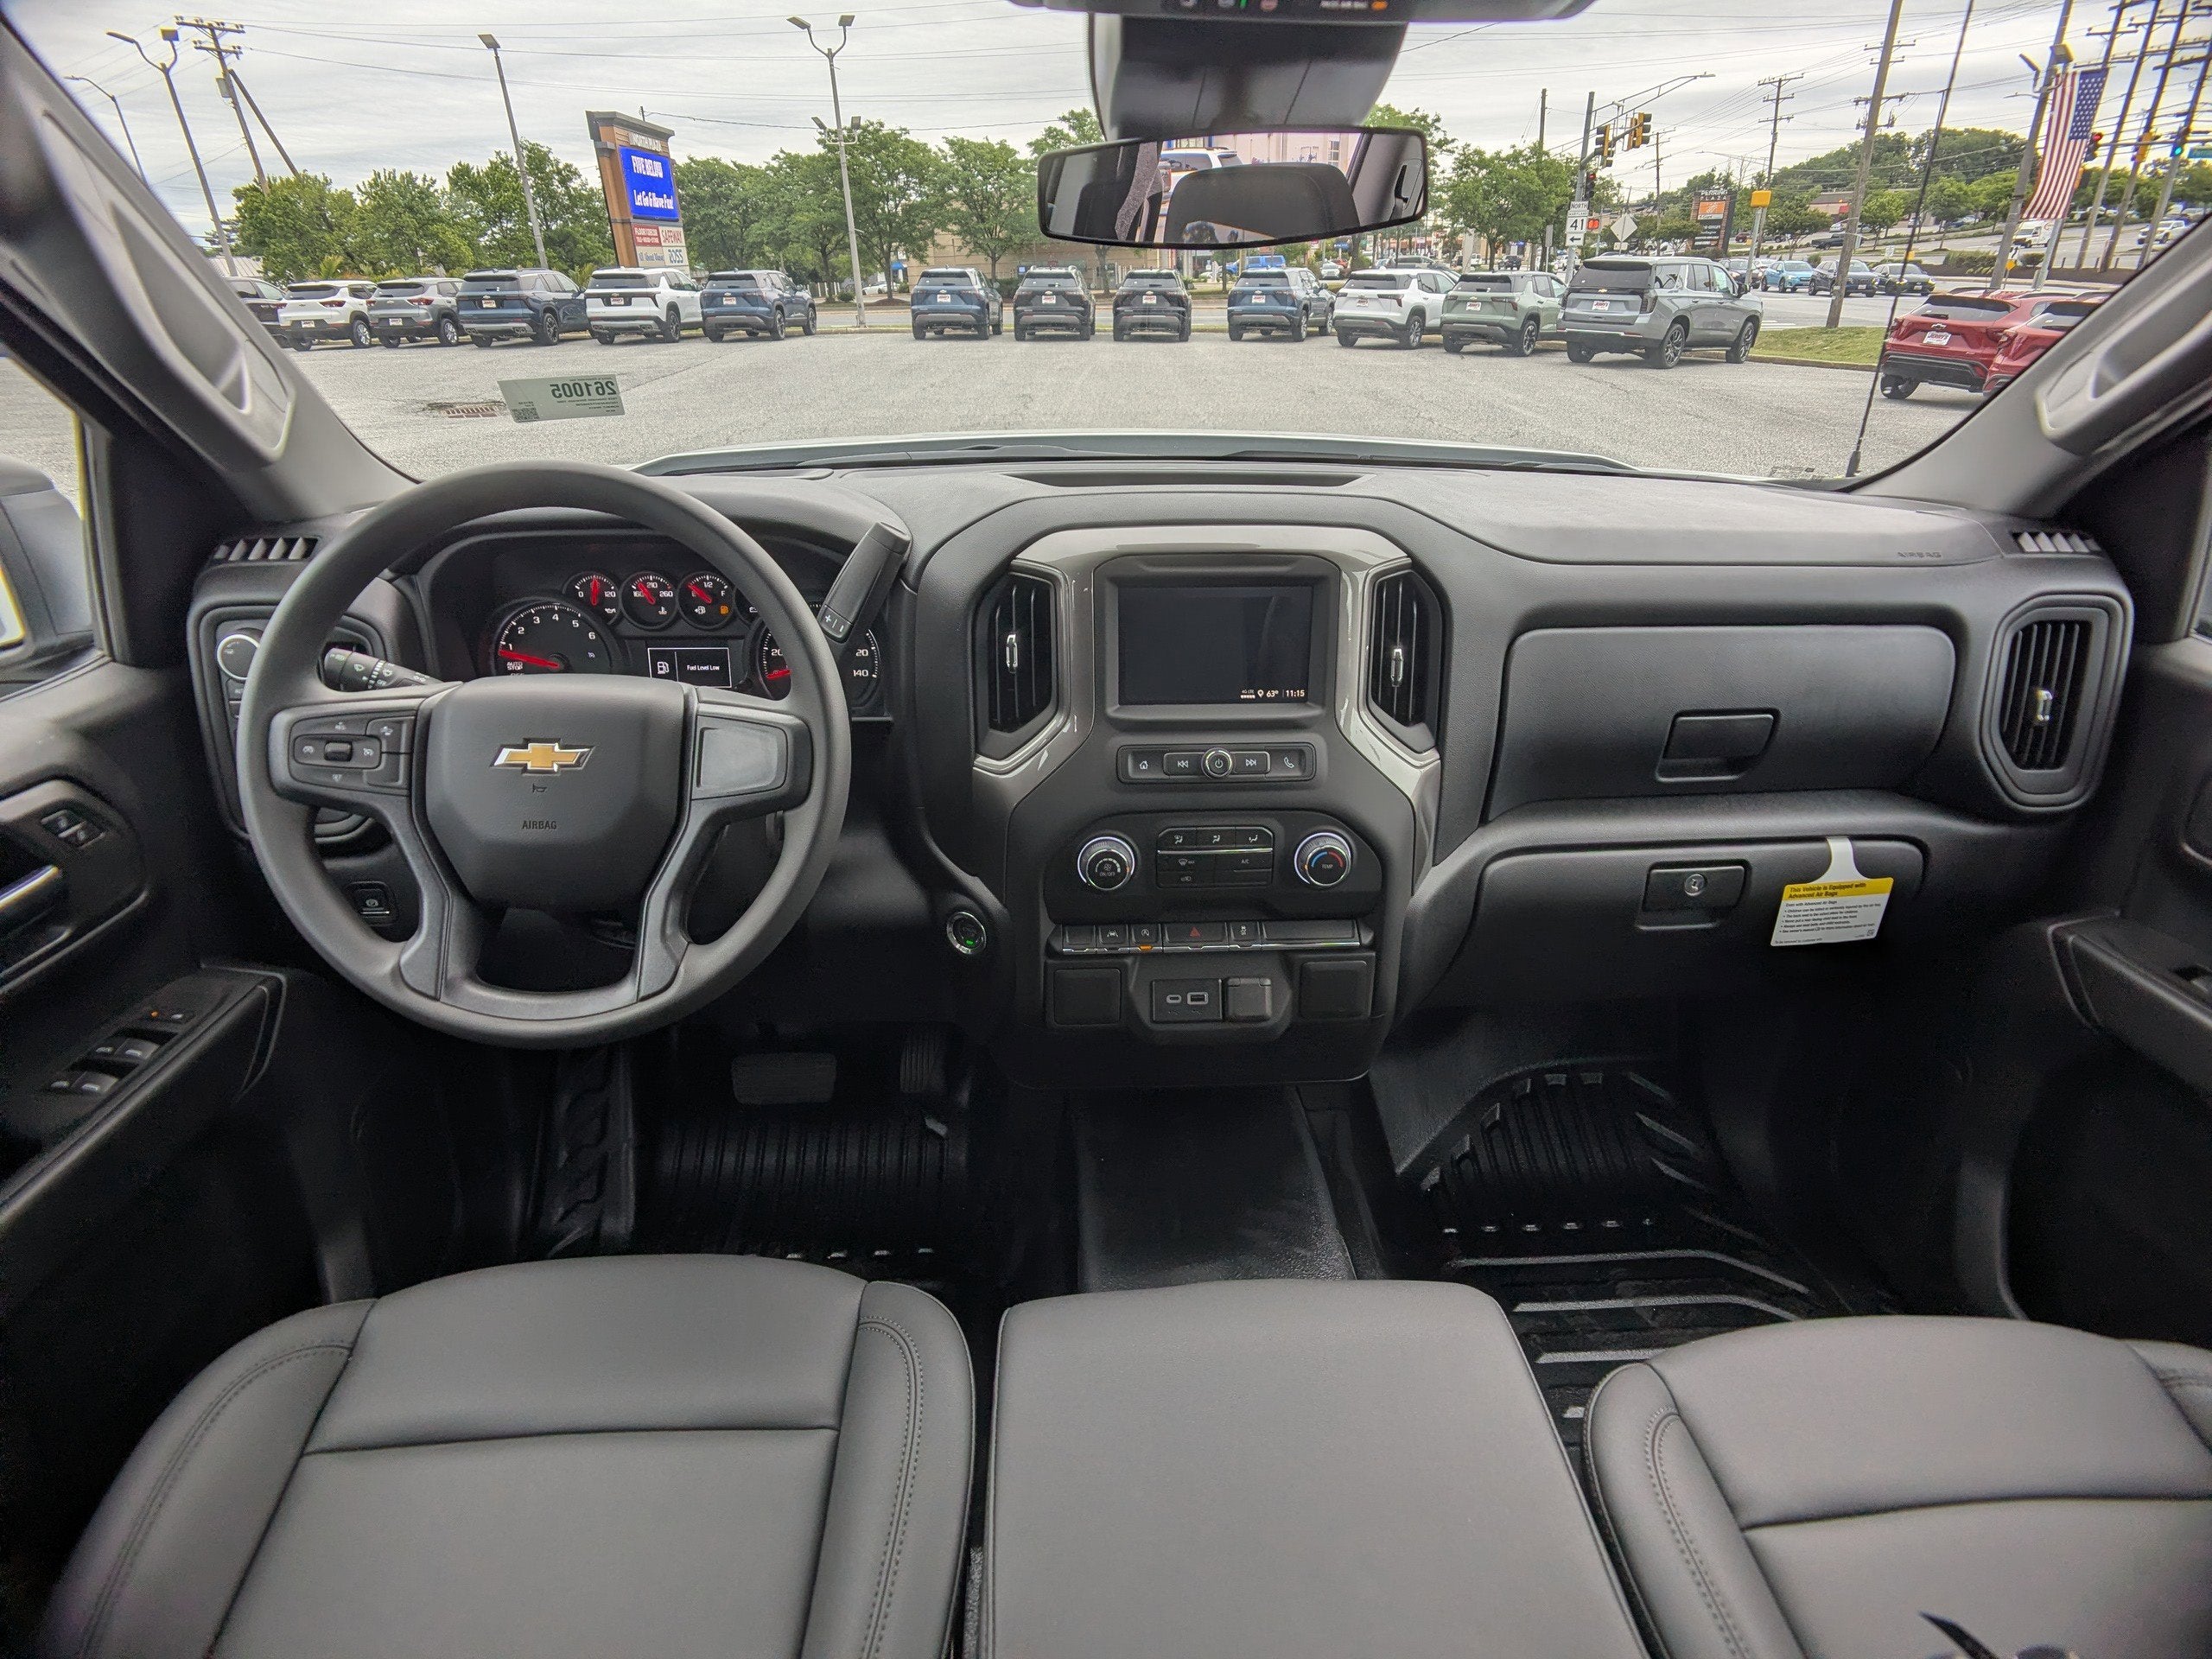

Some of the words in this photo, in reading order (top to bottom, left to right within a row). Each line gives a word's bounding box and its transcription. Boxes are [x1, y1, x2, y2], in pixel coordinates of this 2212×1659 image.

[633, 189, 643, 207] Let
[1570, 219, 1584, 231] 41
[522, 820, 557, 830] AIRBAG
